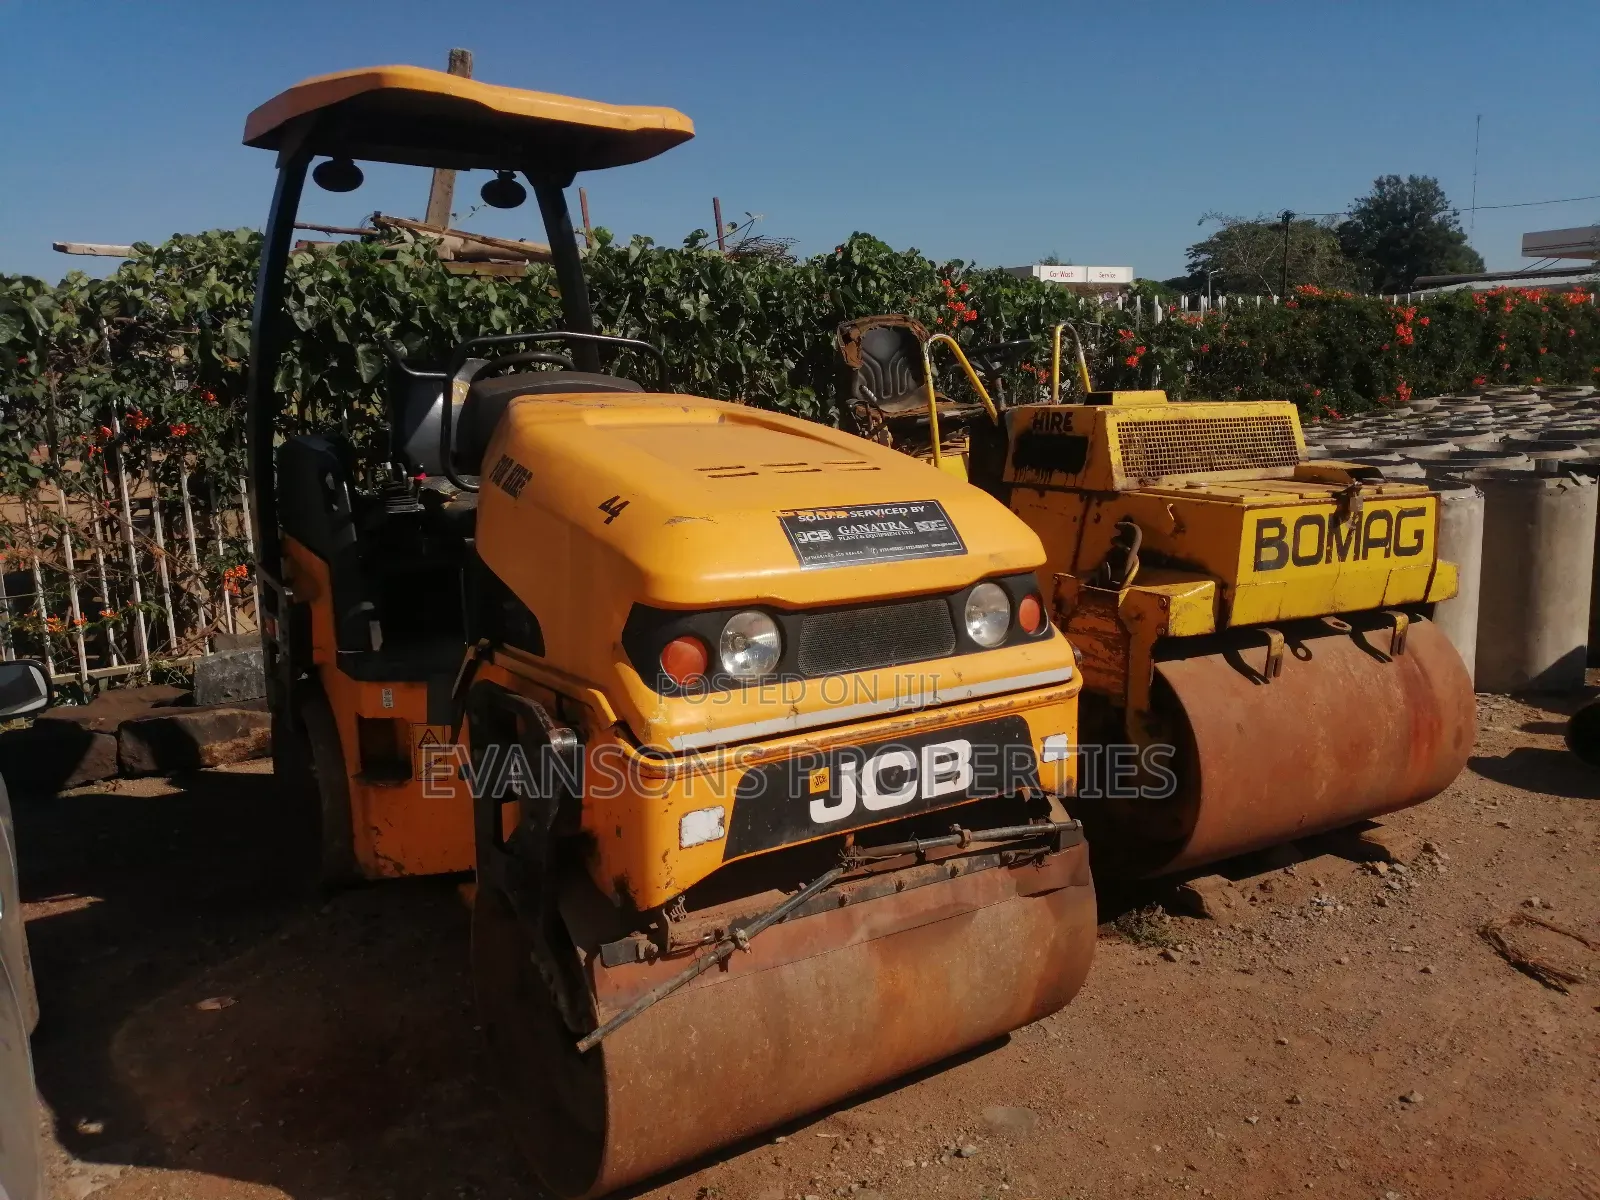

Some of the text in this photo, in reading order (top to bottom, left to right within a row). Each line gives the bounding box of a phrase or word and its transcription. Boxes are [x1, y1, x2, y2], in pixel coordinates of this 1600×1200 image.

[1060, 270, 1074, 278] Wash
[1099, 271, 1116, 279] Service
[1033, 411, 1074, 433] HIRE
[849, 506, 909, 518] SERVICED
[911, 505, 925, 513] BY
[837, 520, 910, 535] GANATRA
[1253, 506, 1427, 572] BOMAG
[809, 738, 974, 824] JCB
